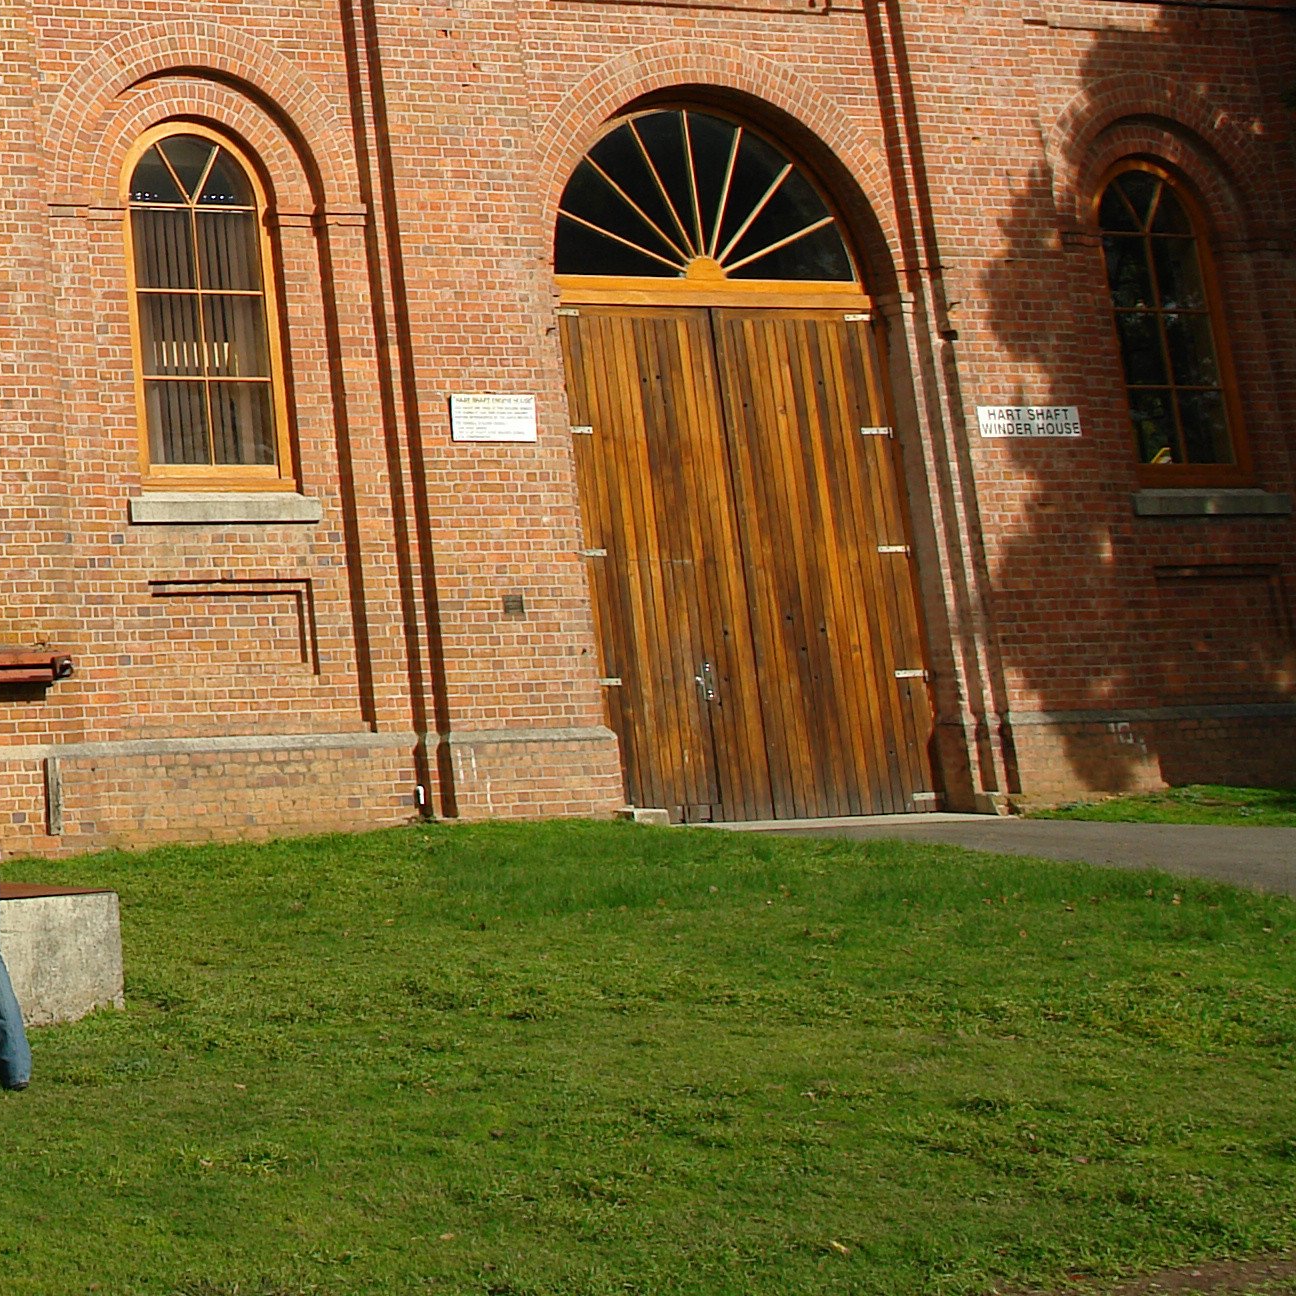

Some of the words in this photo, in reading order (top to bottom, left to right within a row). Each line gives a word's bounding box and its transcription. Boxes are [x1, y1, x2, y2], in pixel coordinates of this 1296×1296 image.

[987, 408, 1022, 421] HART
[1027, 408, 1069, 421] SHAFT
[981, 422, 1033, 435] WINDER
[1037, 422, 1081, 435] HOUSE
